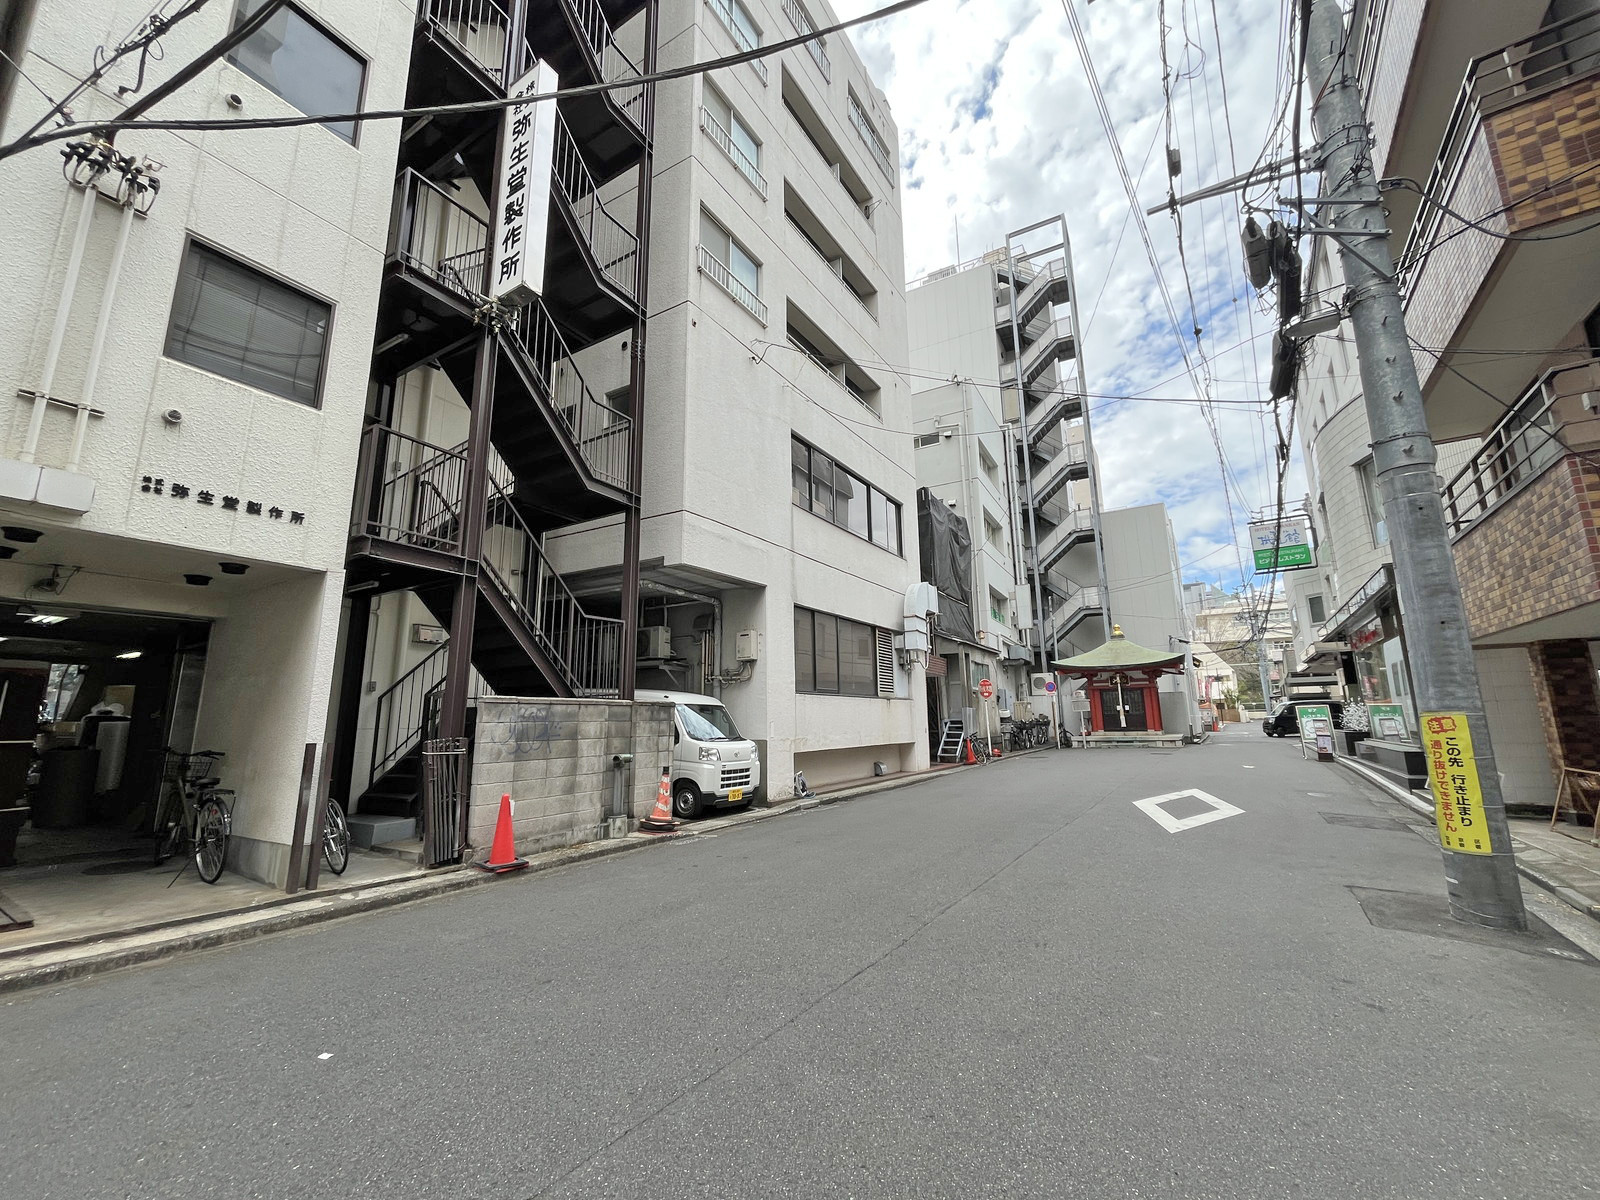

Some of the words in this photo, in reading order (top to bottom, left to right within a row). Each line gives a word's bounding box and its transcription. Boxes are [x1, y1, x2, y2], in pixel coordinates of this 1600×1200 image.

[498, 113, 533, 285] 弥生堂製作所
[170, 482, 305, 525] 弥生堂製作所
[1428, 718, 1456, 732] 注意
[1445, 737, 1464, 768] この先
[1430, 739, 1457, 833] 通り抜けできません
[1450, 774, 1473, 827] 行き止まり
